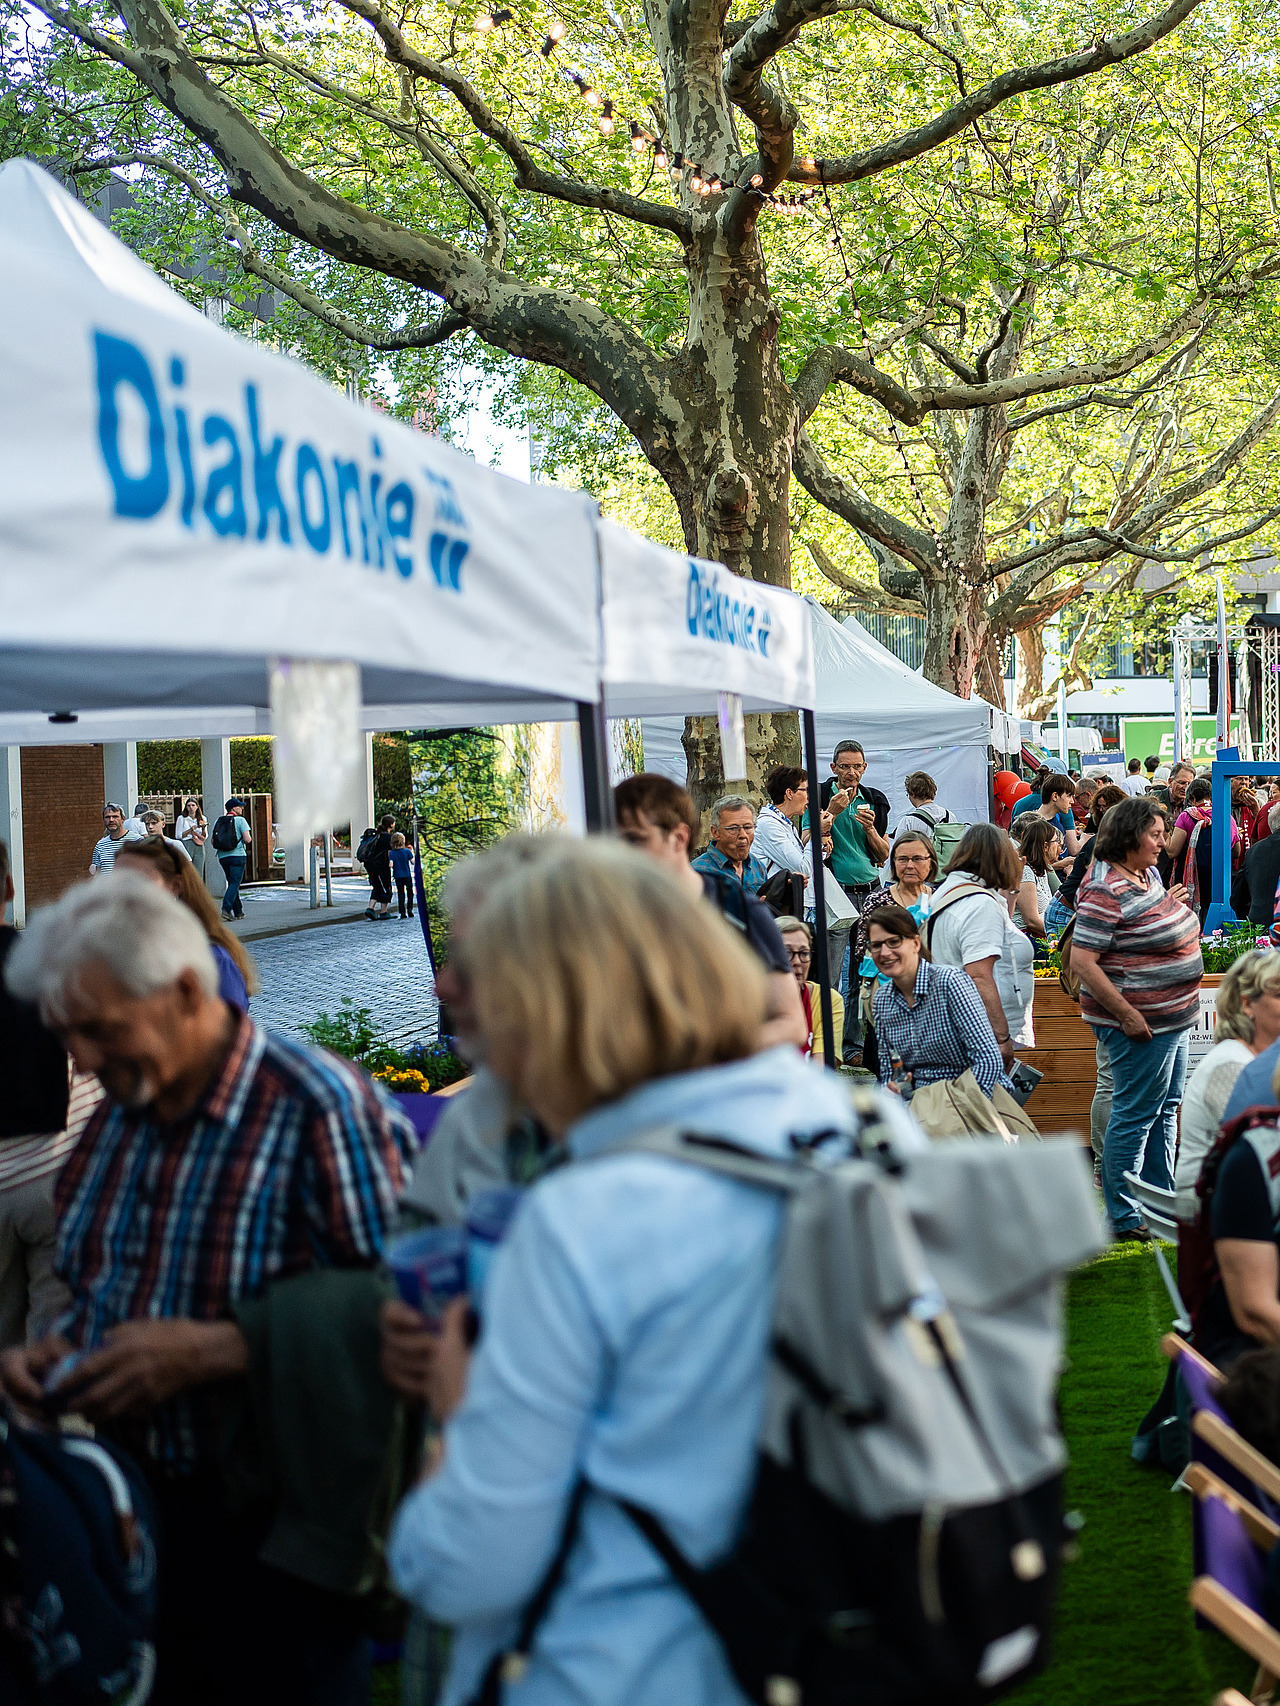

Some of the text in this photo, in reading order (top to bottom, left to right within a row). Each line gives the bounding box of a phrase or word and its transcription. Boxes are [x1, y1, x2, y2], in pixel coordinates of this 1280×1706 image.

[95, 329, 415, 579] Diakonie
[686, 561, 757, 653] Diakonie
[1158, 732, 1217, 756] Ero
